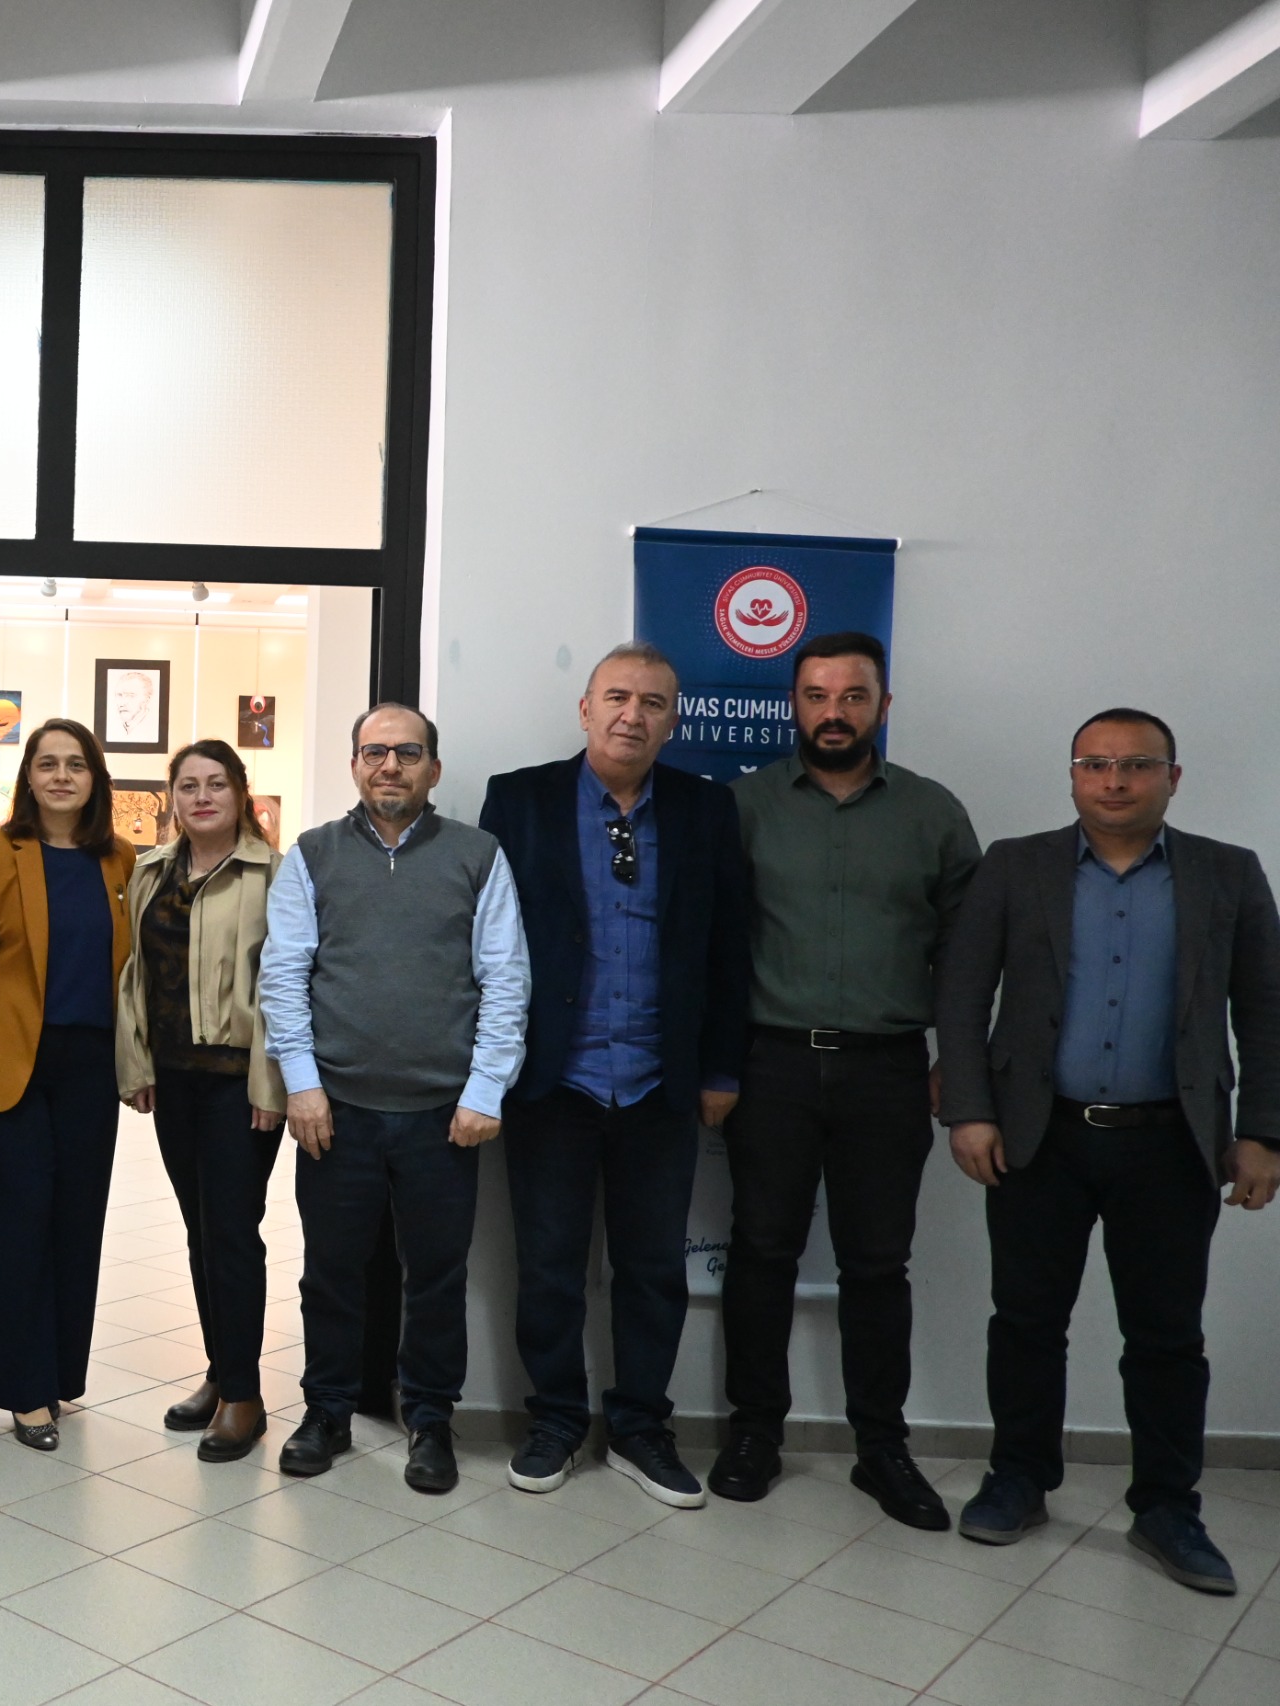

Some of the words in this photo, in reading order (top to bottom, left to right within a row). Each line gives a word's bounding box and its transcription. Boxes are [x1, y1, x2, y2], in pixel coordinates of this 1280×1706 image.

[676, 692, 720, 718] İVAS
[724, 698, 793, 721] CUMHU
[667, 721, 797, 745] NİVERSİT
[684, 1236, 729, 1257] Gelene
